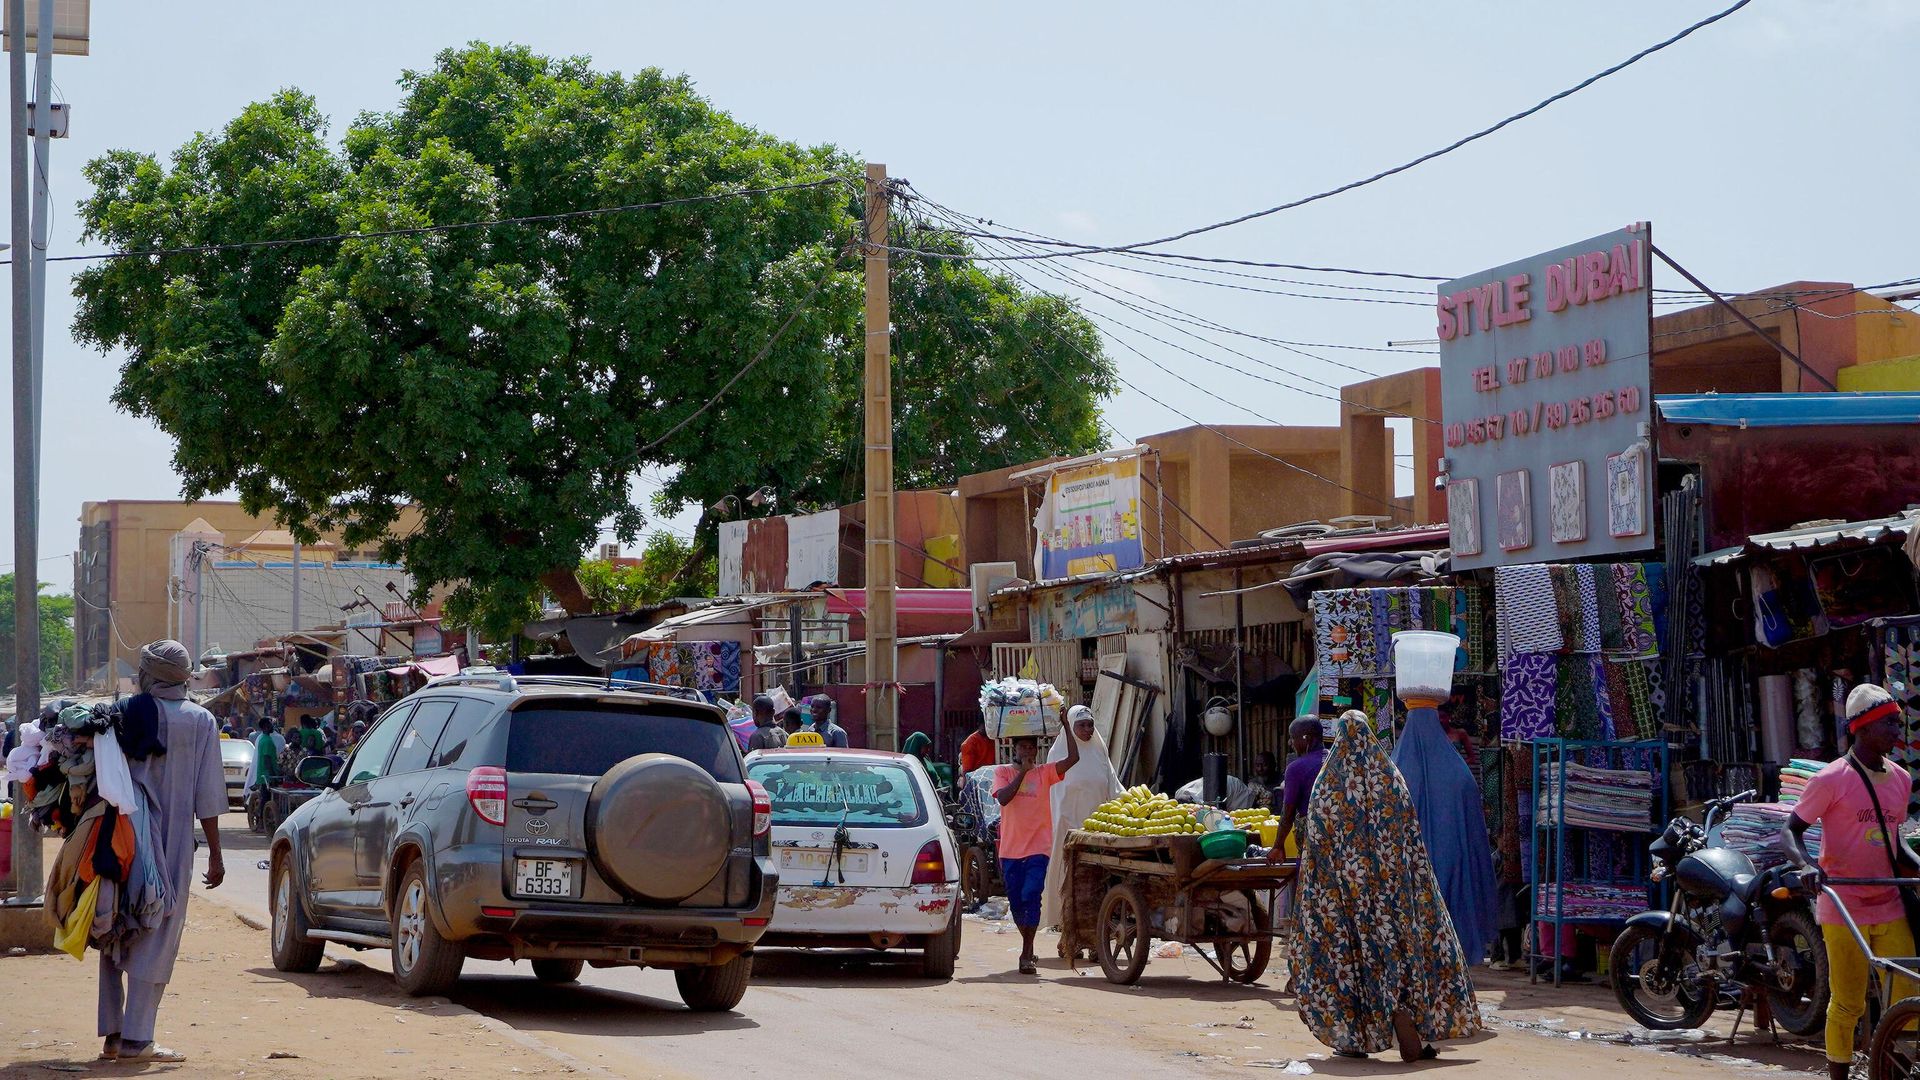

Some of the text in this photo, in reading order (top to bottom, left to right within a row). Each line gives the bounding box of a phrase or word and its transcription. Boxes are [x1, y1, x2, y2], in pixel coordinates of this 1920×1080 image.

[1437, 239, 1646, 340] STYLE DUBAI
[1569, 397, 1590, 424] 26
[1593, 391, 1615, 418] 26
[795, 735, 818, 744] TAXI
[535, 861, 554, 878] BF
[525, 877, 562, 894] 6333
